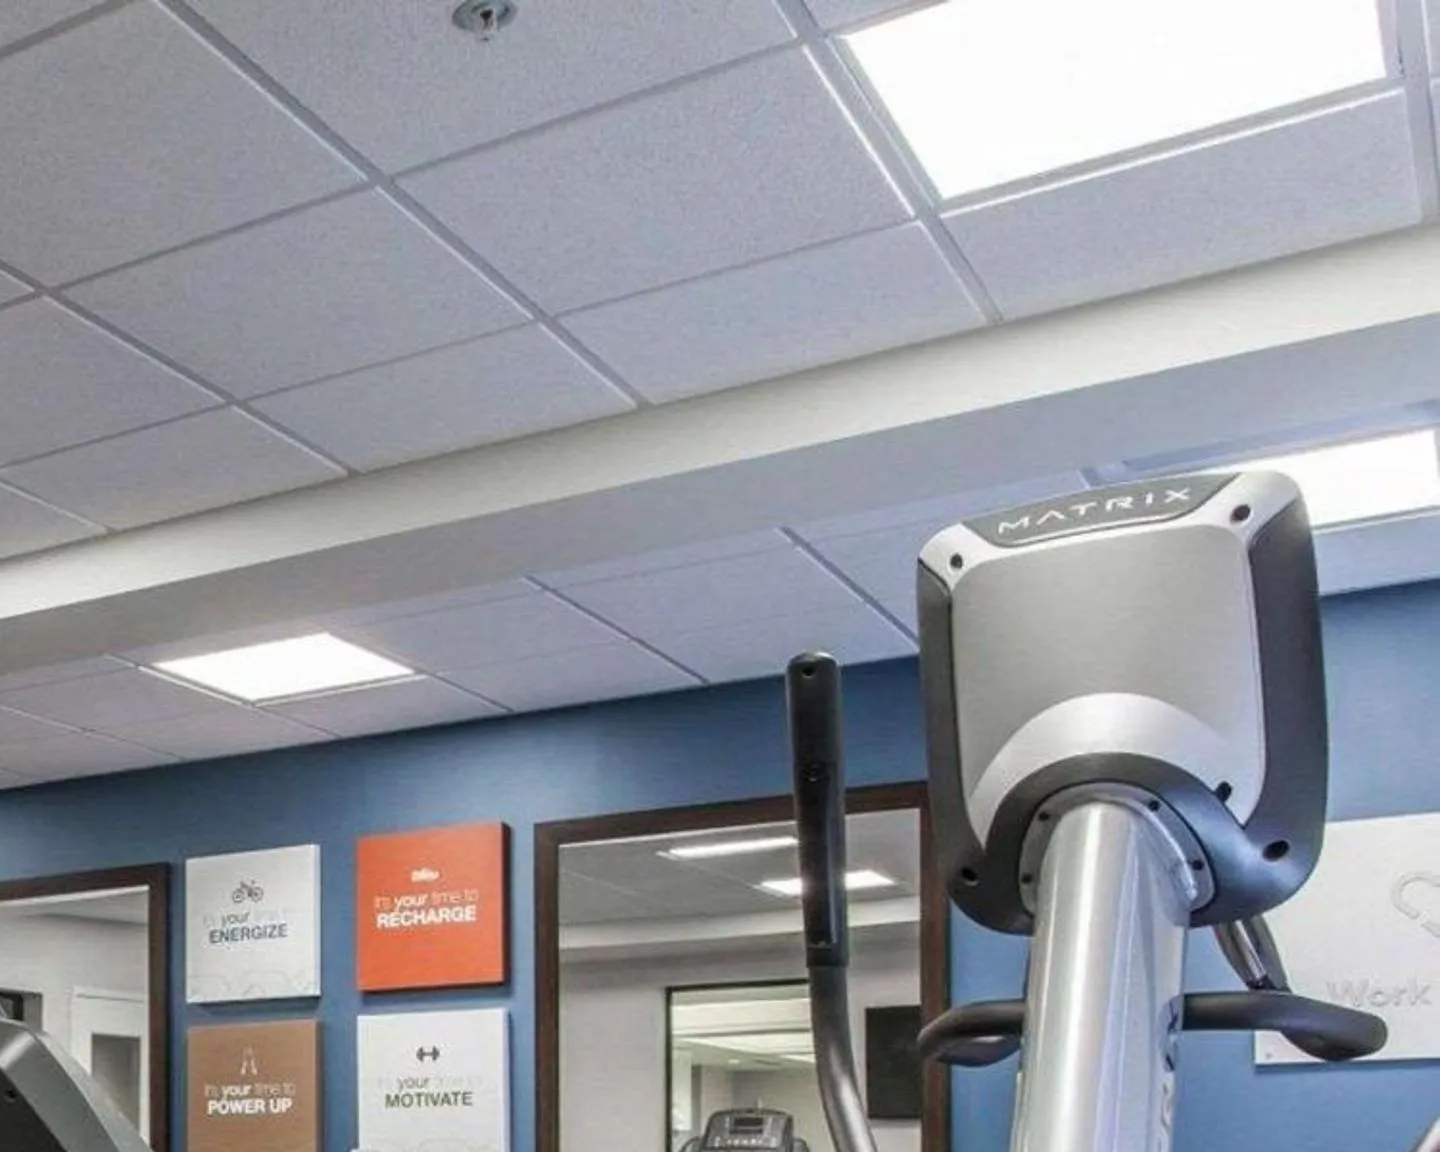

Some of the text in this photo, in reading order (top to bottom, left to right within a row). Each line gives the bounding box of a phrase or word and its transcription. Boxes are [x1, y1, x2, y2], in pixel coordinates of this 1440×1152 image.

[998, 488, 1190, 535] MATRIX
[394, 893, 428, 912] your
[221, 911, 250, 928] your
[376, 904, 477, 929] RECHARGE
[209, 922, 288, 944] ENERGIZE
[1325, 977, 1432, 1008] Work
[222, 1085, 253, 1101] your
[397, 1077, 430, 1093] your
[207, 1097, 293, 1115] POWER UP
[385, 1091, 474, 1108] MOTIVATE
